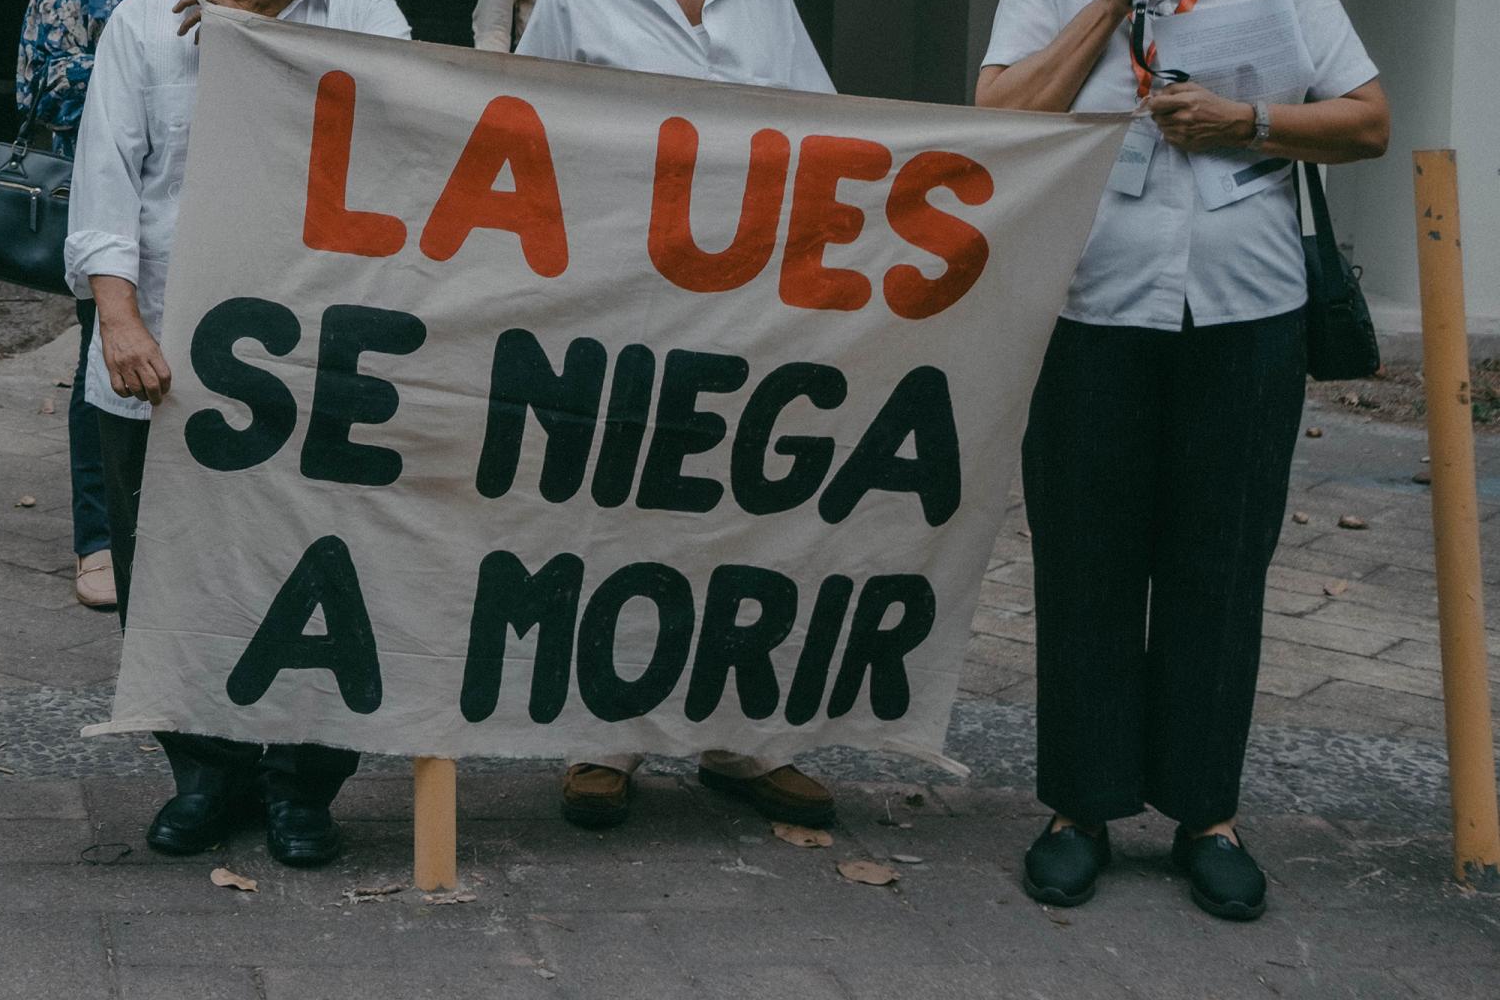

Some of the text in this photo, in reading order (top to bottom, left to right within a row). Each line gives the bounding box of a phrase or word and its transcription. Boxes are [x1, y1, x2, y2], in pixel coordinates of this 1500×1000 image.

[302, 70, 994, 319] LA UES
[184, 296, 961, 527] SE NIEGA
[226, 535, 936, 725] A MORIR
